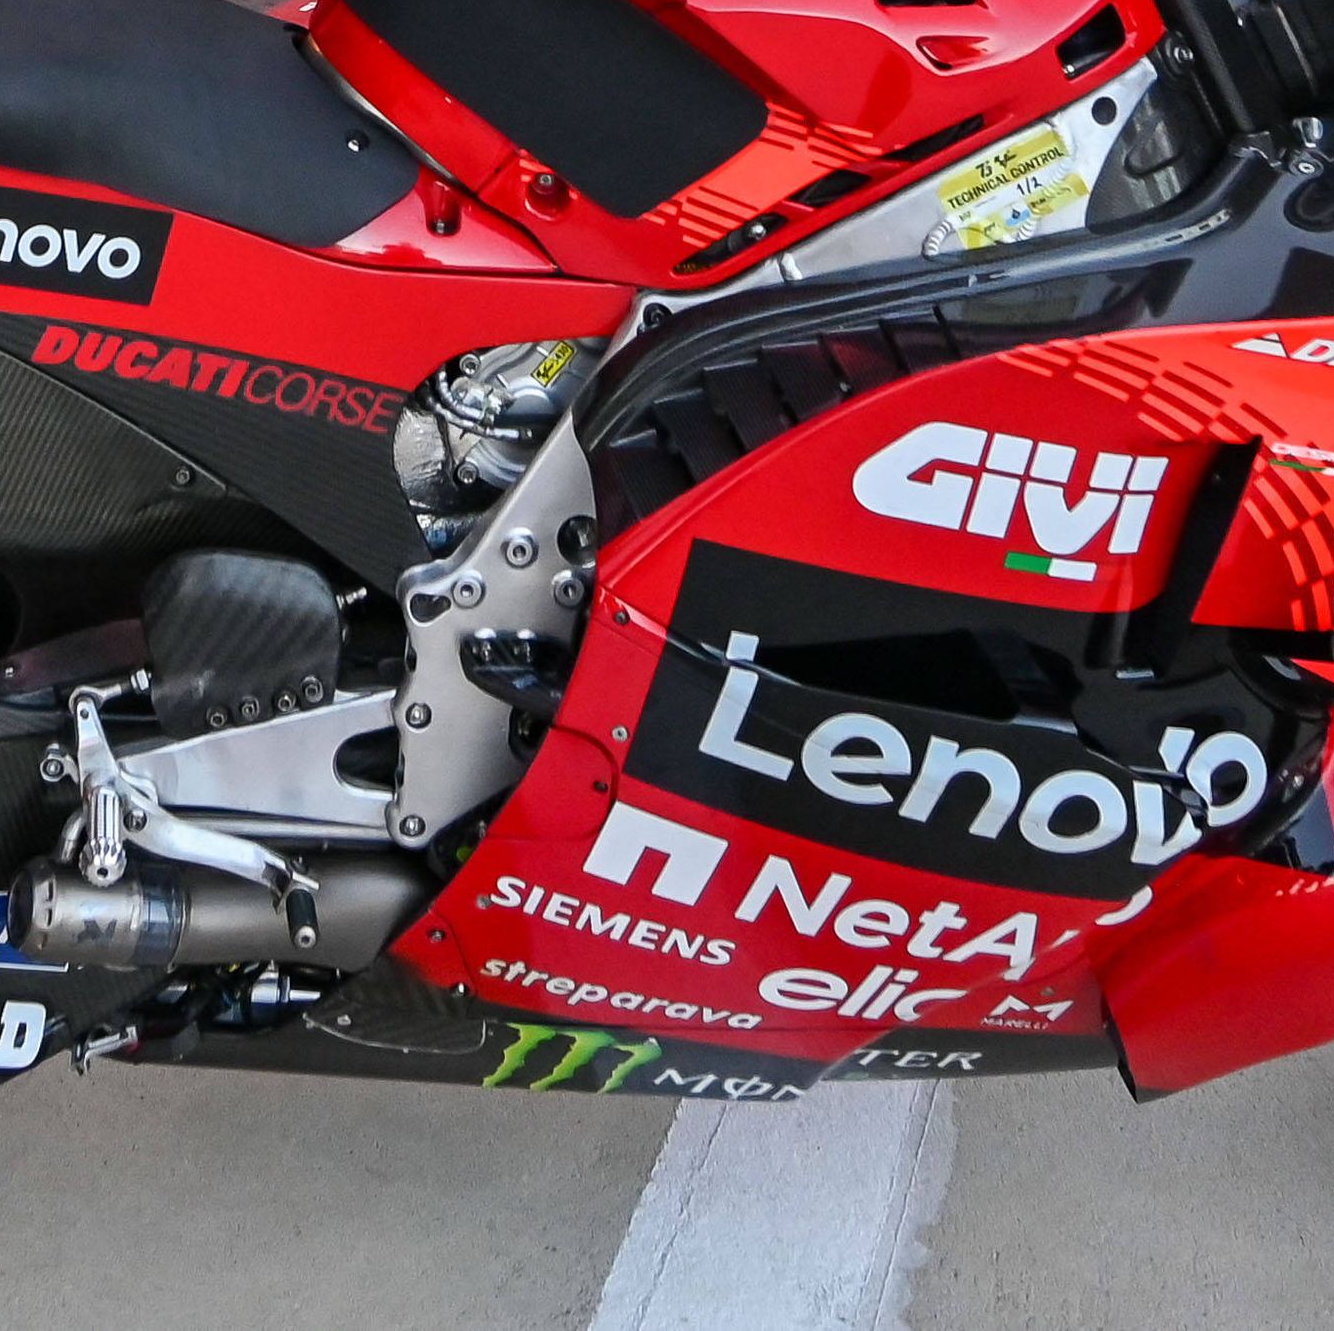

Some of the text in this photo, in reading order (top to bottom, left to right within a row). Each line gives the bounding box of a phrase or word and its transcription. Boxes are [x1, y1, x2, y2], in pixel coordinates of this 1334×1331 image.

[947, 143, 1065, 211] TECHNICAL CONTROL
[1017, 175, 1043, 197] 1/2
[849, 420, 1170, 557] GIVI
[696, 629, 1268, 868] Lenovo
[487, 874, 737, 968] SIEMENS
[736, 853, 1153, 983] NetA
[478, 955, 763, 1029] streparava
[759, 968, 969, 1040] elic
[652, 1048, 982, 1103] MONTER
